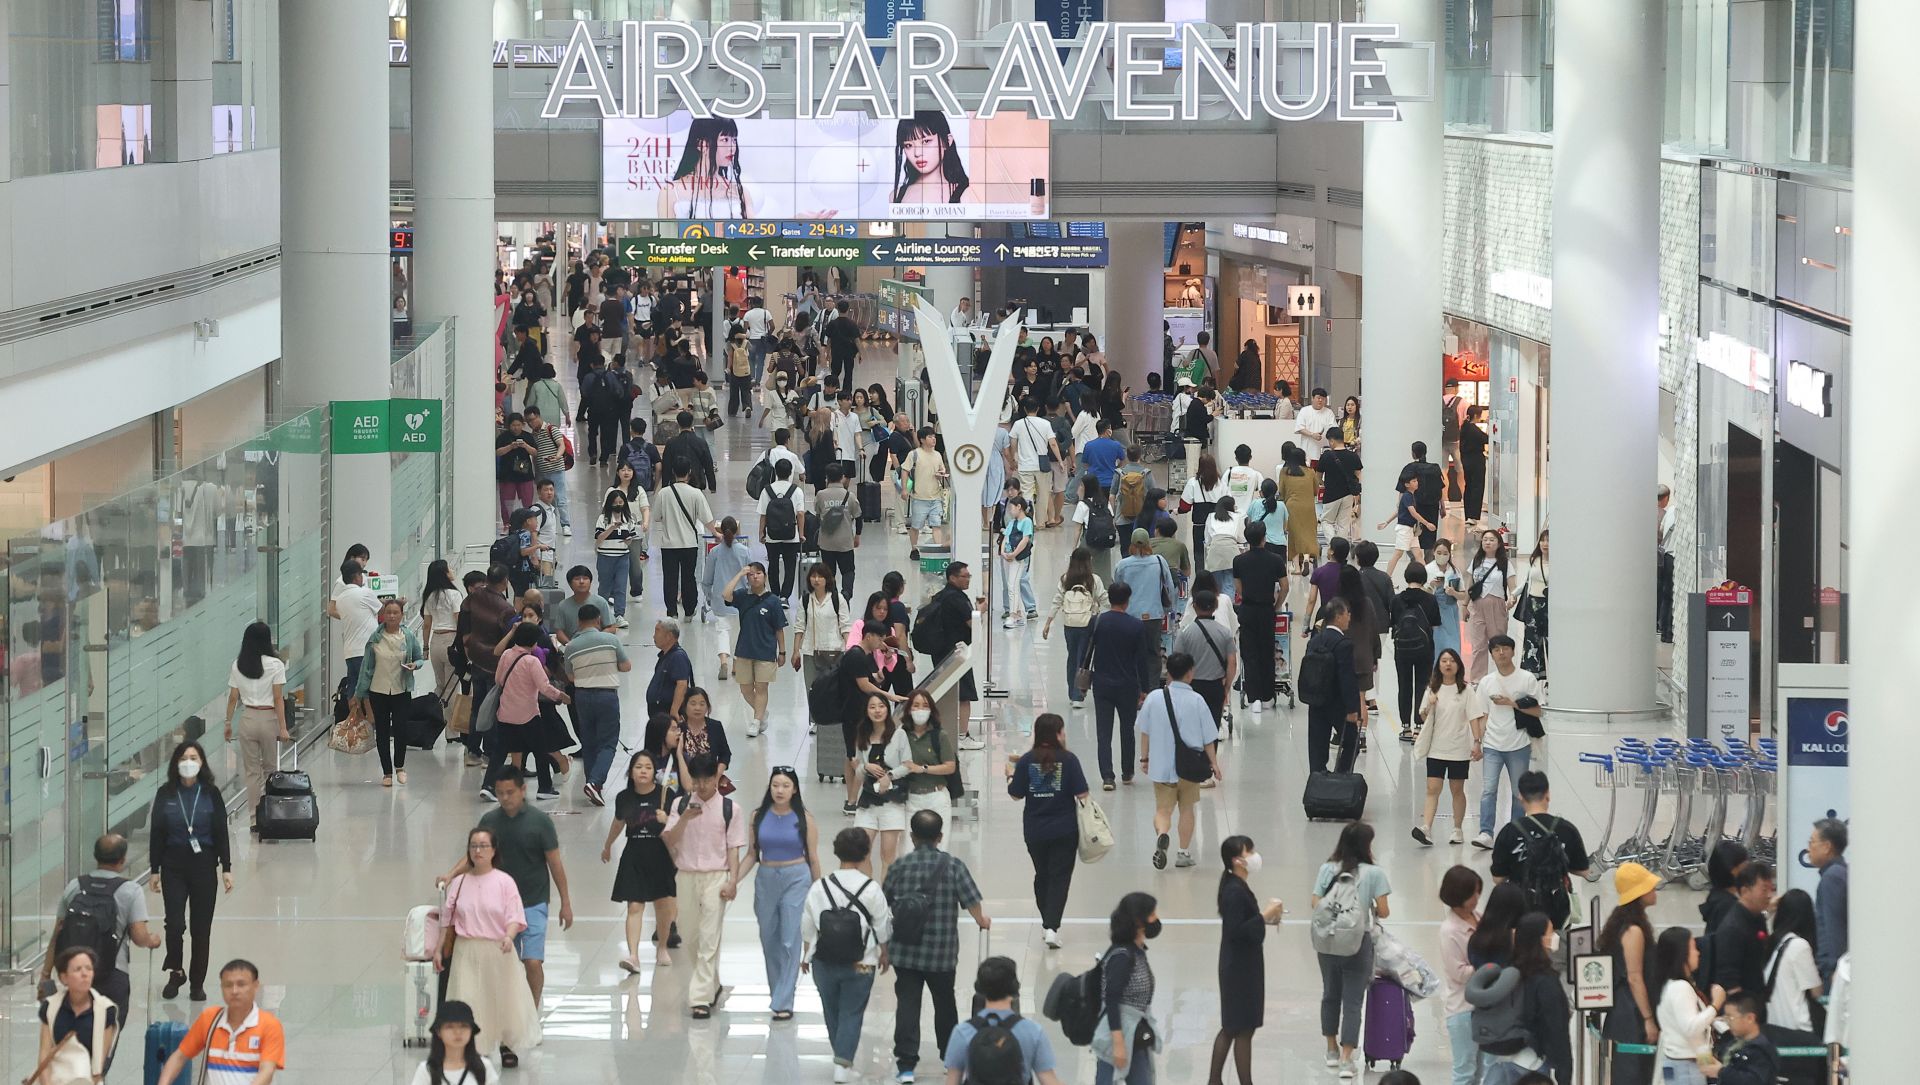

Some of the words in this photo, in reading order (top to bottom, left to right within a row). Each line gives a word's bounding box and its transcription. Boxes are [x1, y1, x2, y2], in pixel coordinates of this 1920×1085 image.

[1060, 11, 1070, 38] COUR
[541, 20, 966, 120] AIRSTAR
[976, 21, 1400, 121] AVENUE
[627, 137, 671, 158] 24H
[628, 159, 677, 174] BARE
[627, 175, 731, 190] SENSATION
[892, 206, 930, 216] GIORGIO
[932, 206, 966, 216] ARMANI
[738, 223, 776, 236] 42-50
[782, 228, 801, 236] Gates
[808, 223, 845, 236] 29-41
[648, 243, 698, 255] Transfer
[700, 243, 729, 255] Desk
[770, 245, 815, 258] Transfer
[817, 245, 860, 260] Lounge
[894, 242, 932, 255] Airline
[934, 243, 981, 258] Lounges
[648, 255, 668, 263] Other
[669, 255, 695, 263] Airlines
[354, 416, 379, 428] AED
[402, 433, 427, 442] AED
[1801, 743, 1826, 753] KAL
[1826, 743, 1850, 753] LOU
